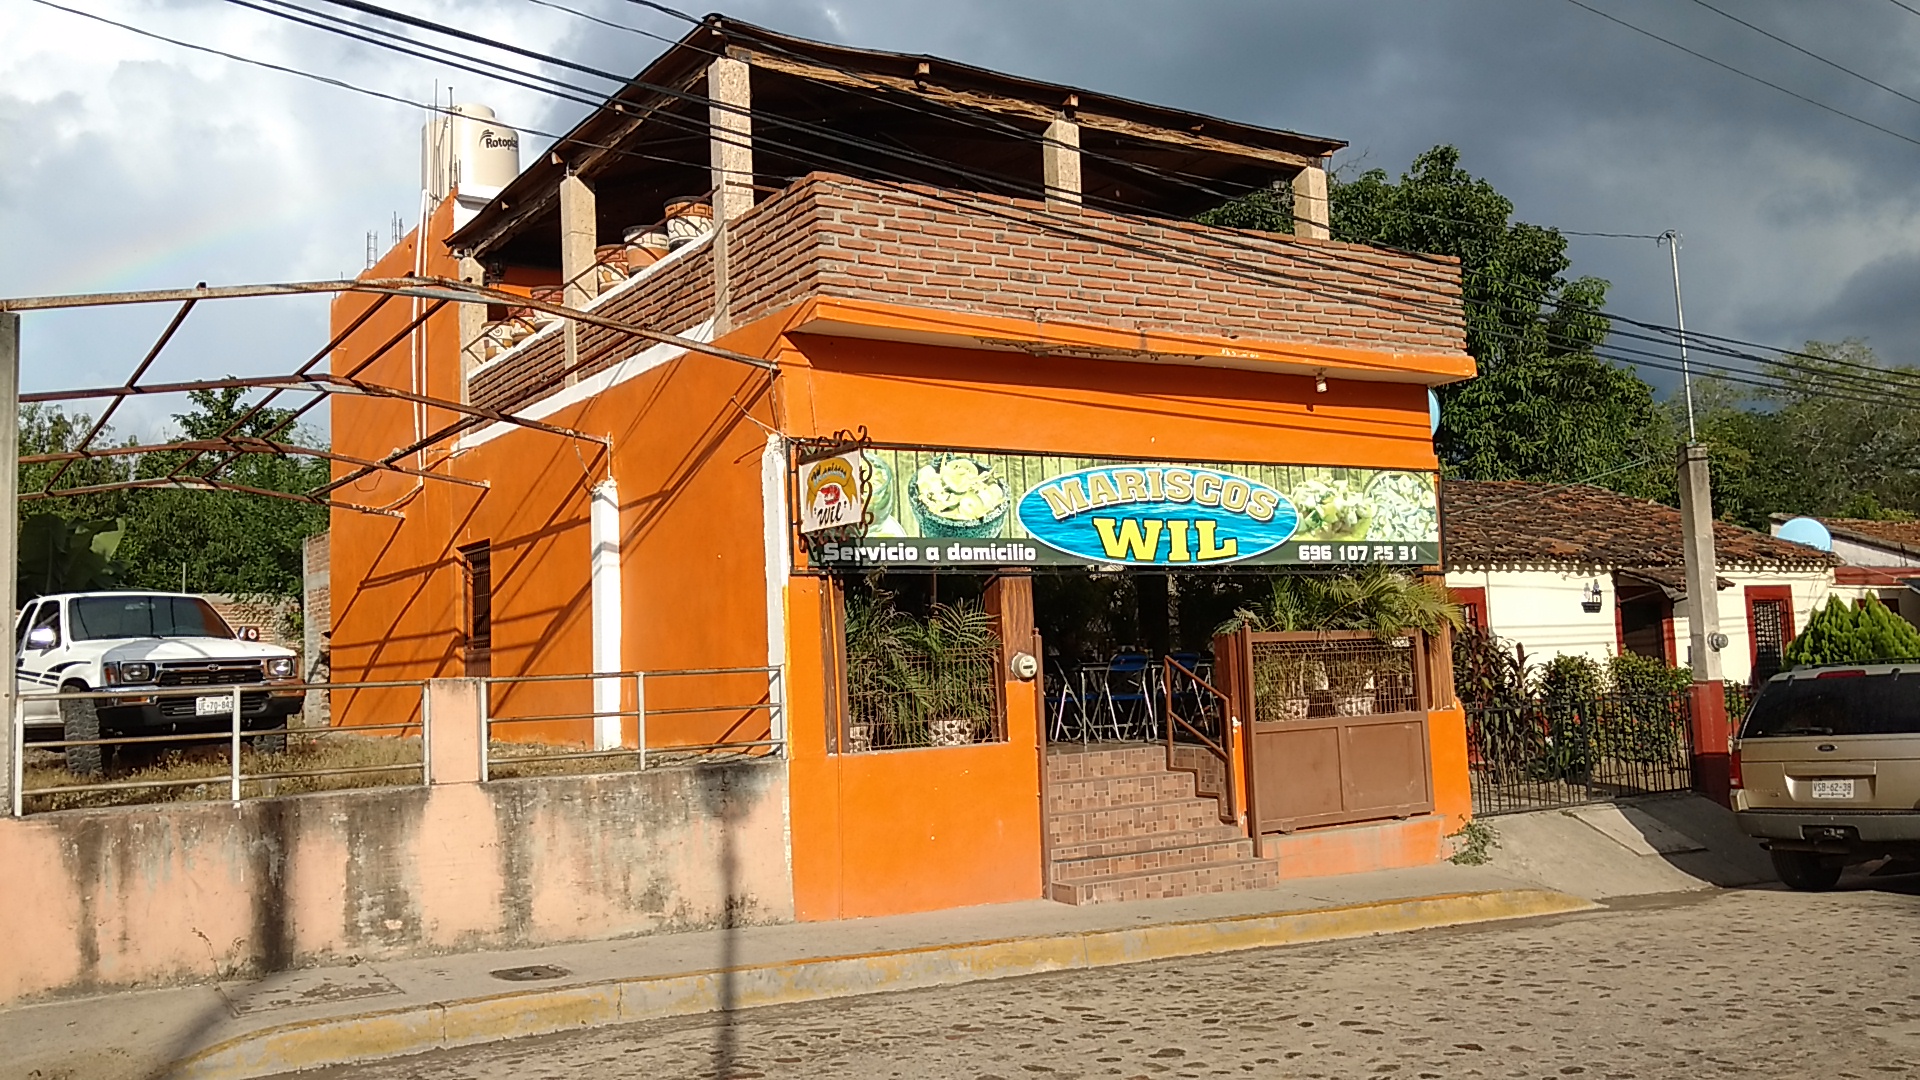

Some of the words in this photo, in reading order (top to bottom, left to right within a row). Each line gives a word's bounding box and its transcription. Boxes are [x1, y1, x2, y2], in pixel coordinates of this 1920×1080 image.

[1040, 468, 1279, 521] MARISCOS
[824, 542, 918, 561] Servicio
[926, 549, 940, 561] a
[947, 543, 1036, 561] domicilio
[1091, 517, 1238, 562] WIL
[1299, 544, 1332, 561] 696
[1338, 544, 1369, 561] 107
[1373, 545, 1394, 561] 25
[1398, 545, 1417, 561] 31
